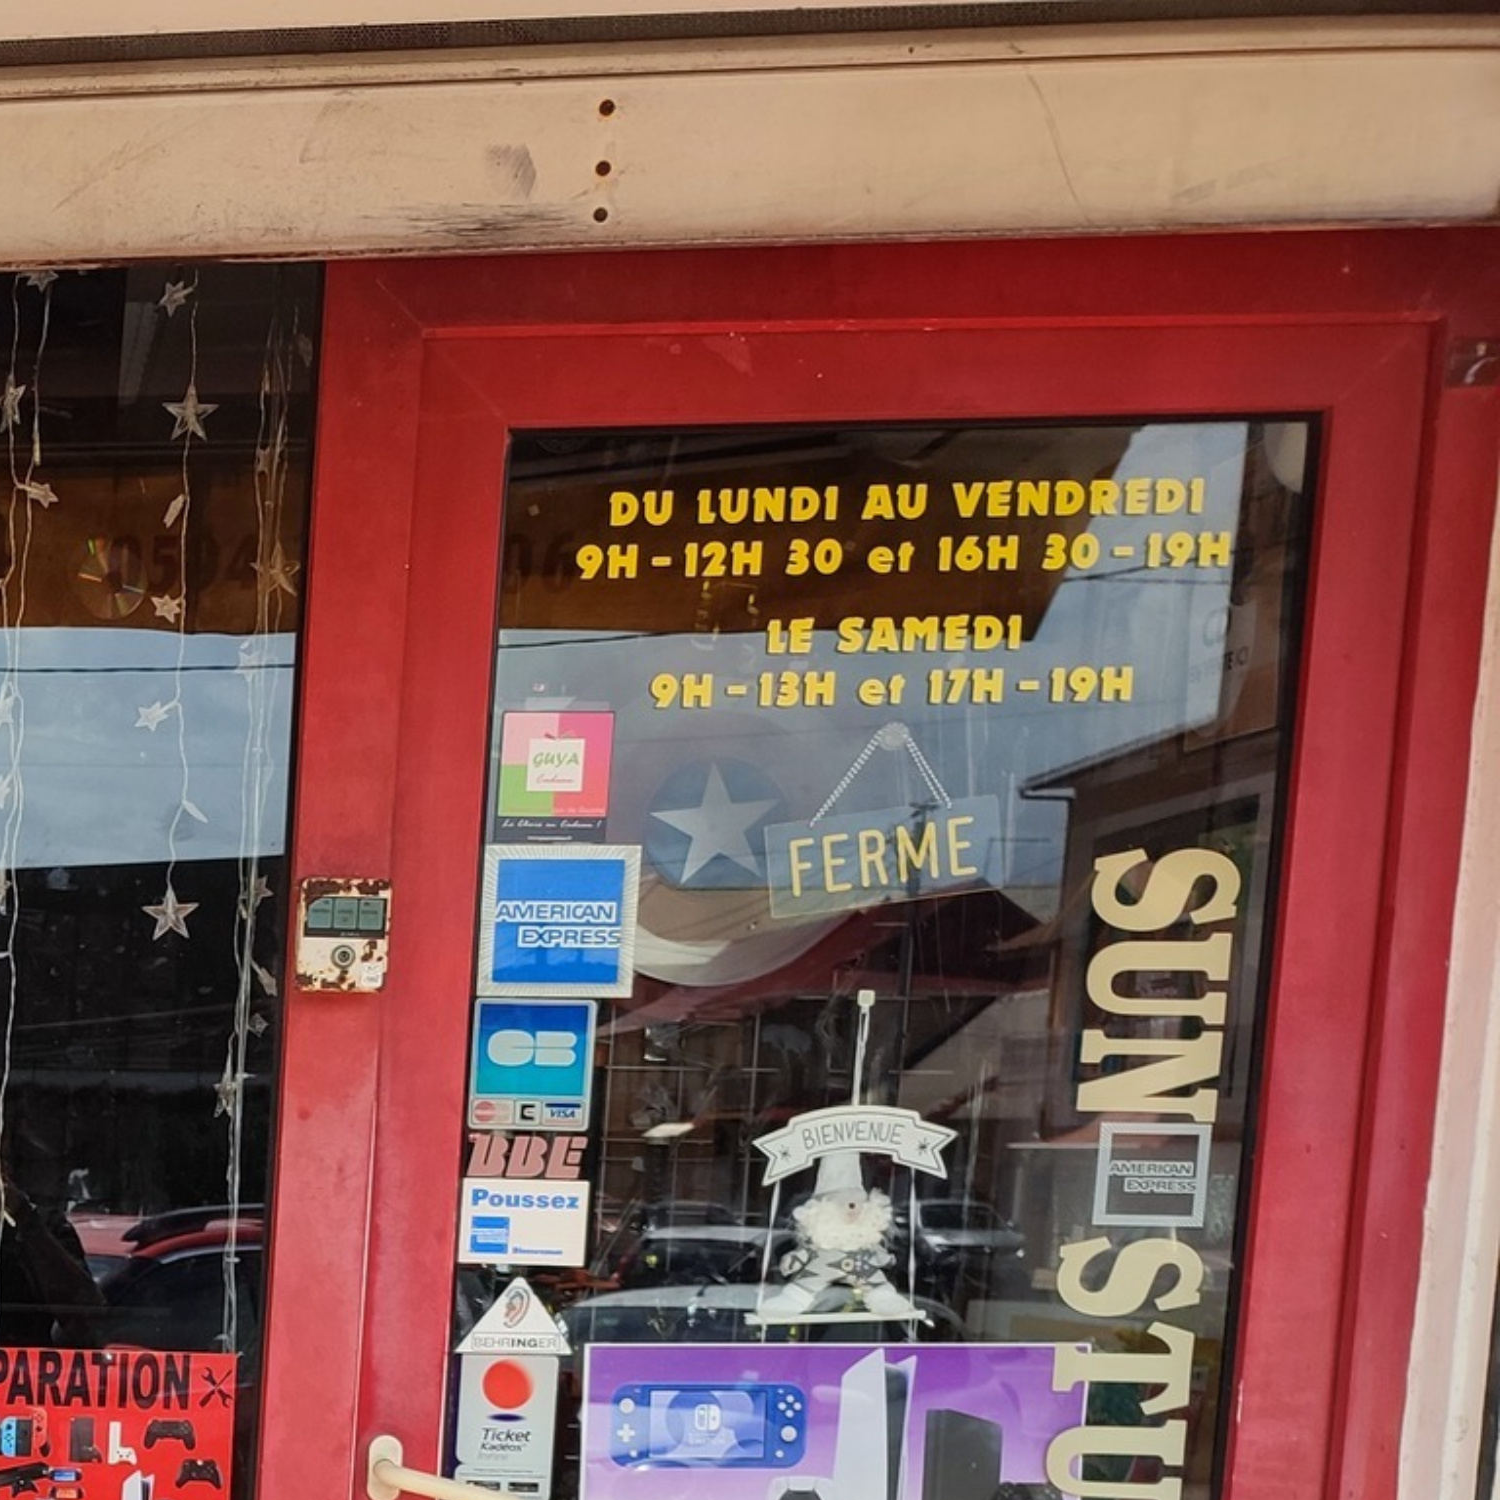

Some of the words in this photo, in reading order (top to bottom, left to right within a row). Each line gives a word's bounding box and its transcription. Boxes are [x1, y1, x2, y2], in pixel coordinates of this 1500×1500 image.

[610, 491, 673, 527] DU
[698, 486, 838, 524] LUNDI
[862, 483, 928, 520] AU
[952, 478, 1205, 519] VENDREDI
[785, 538, 843, 575] 30
[868, 536, 915, 574] et
[937, 534, 1019, 572] 16H
[766, 617, 814, 655] LE
[836, 614, 1023, 653] SAMEDI
[858, 668, 906, 705] et
[788, 814, 978, 899] FERME
[496, 903, 614, 920] AMERICAN
[520, 928, 622, 945] EXPRESS
[487, 1029, 578, 1067] CB
[549, 1109, 576, 1119] VISA
[801, 1119, 906, 1151] BIENVENUE
[466, 1134, 589, 1179] BBE
[1109, 1162, 1192, 1176] AMERICAN
[1126, 1178, 1197, 1191] EXPRESS
[471, 1188, 579, 1210] Poussez
[472, 1337, 558, 1349] BEHRINGER
[480, 1428, 531, 1443] Ticket
